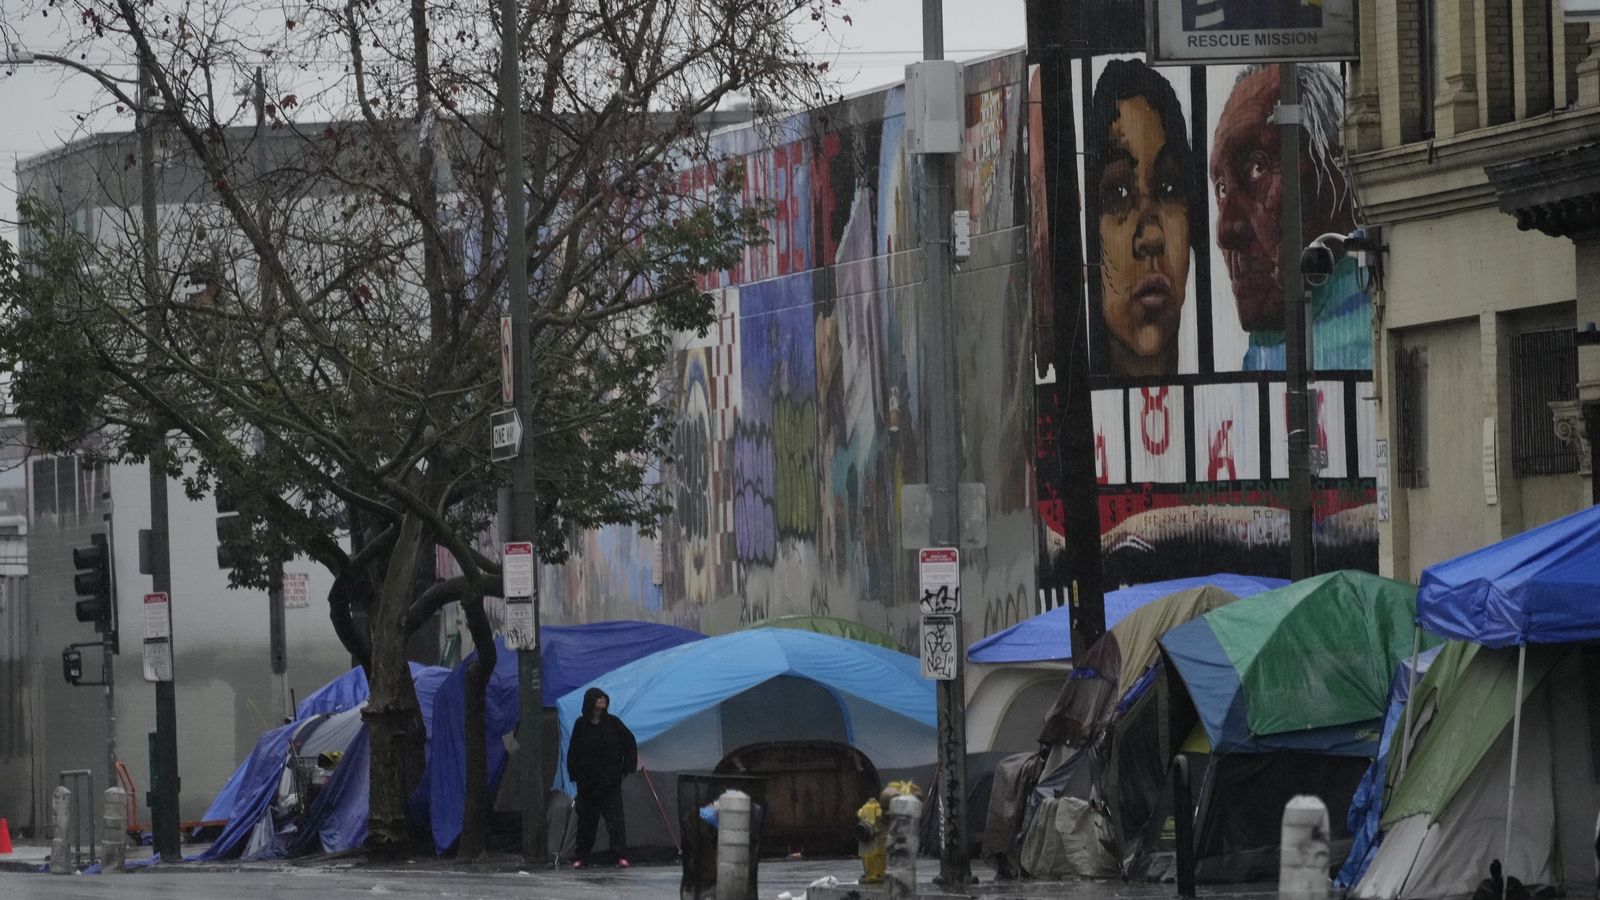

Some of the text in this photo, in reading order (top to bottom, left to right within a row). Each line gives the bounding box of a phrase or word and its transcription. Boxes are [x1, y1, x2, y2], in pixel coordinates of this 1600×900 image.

[1187, 32, 1318, 48] RESCUE MISSION
[495, 426, 505, 445] ONE
